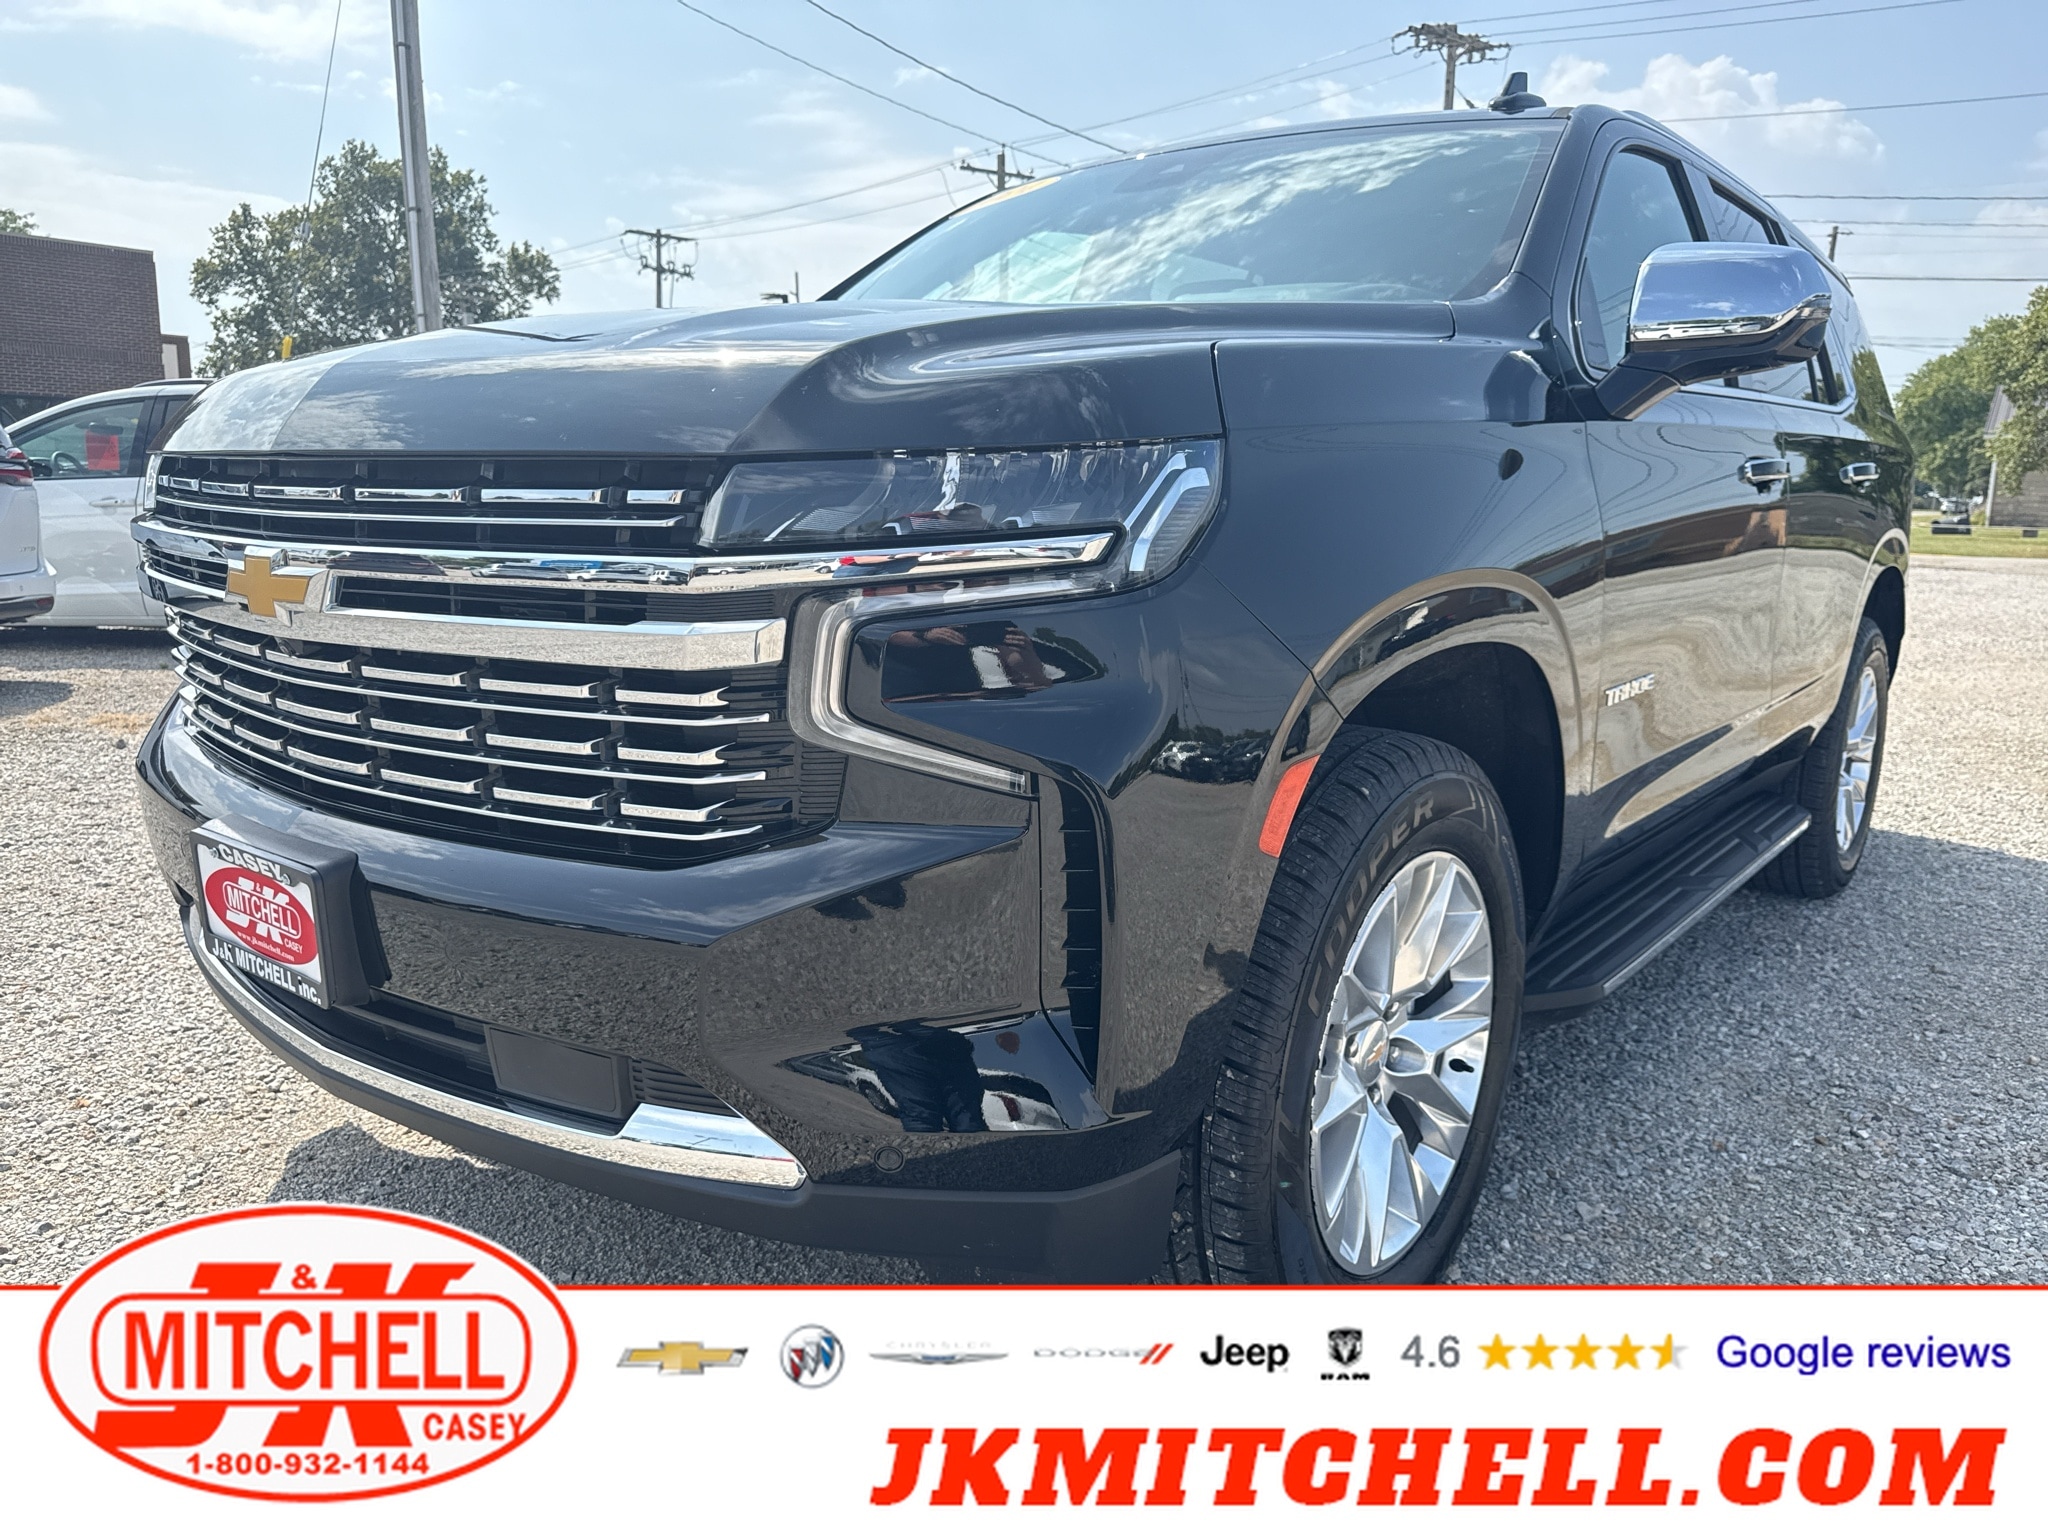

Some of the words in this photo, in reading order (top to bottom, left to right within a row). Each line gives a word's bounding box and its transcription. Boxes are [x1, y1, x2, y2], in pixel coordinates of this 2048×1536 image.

[1605, 672, 1655, 706] TAHOE
[219, 843, 283, 880] CASEY
[226, 885, 298, 936] MITCHELL
[1307, 791, 1434, 1018] COOPER
[284, 937, 303, 954] CASEY
[235, 947, 296, 993] MITCHELL
